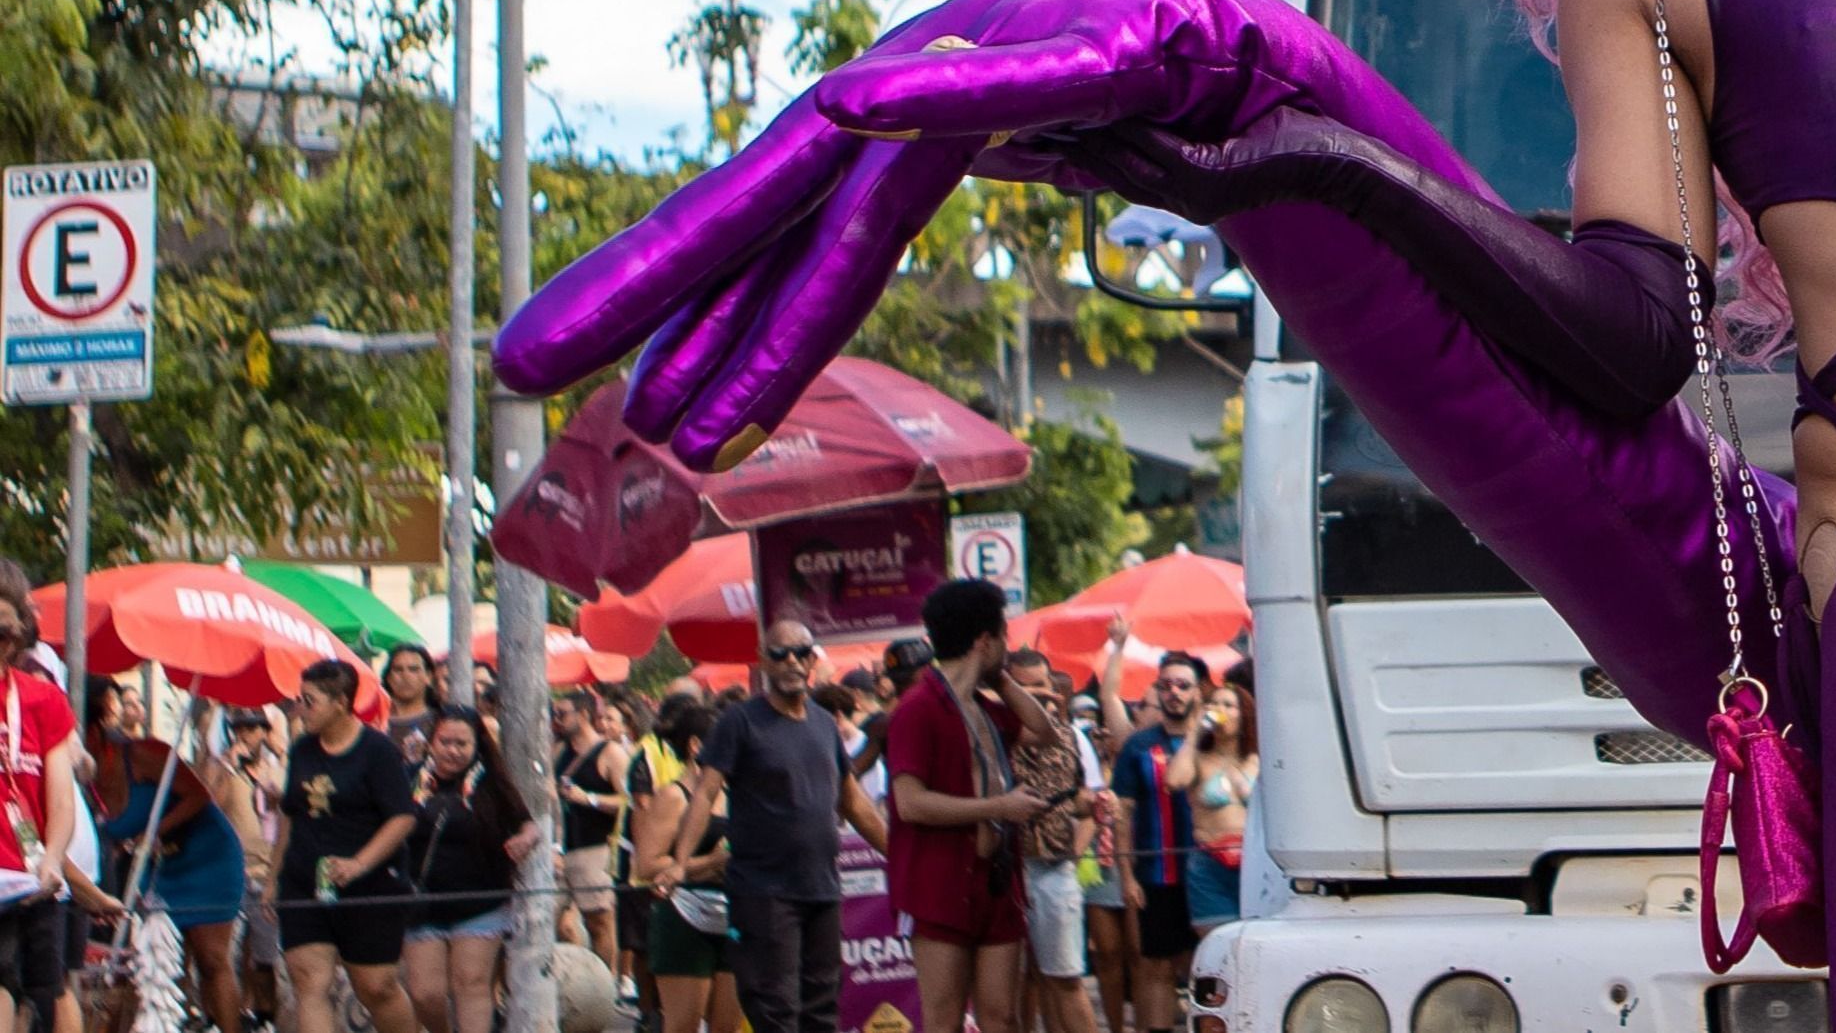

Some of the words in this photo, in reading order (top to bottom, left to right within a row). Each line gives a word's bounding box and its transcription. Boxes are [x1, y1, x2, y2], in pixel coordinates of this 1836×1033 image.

[10, 167, 148, 198] ROTATIVO
[55, 222, 99, 295] E
[176, 588, 337, 661] BRAHMA
